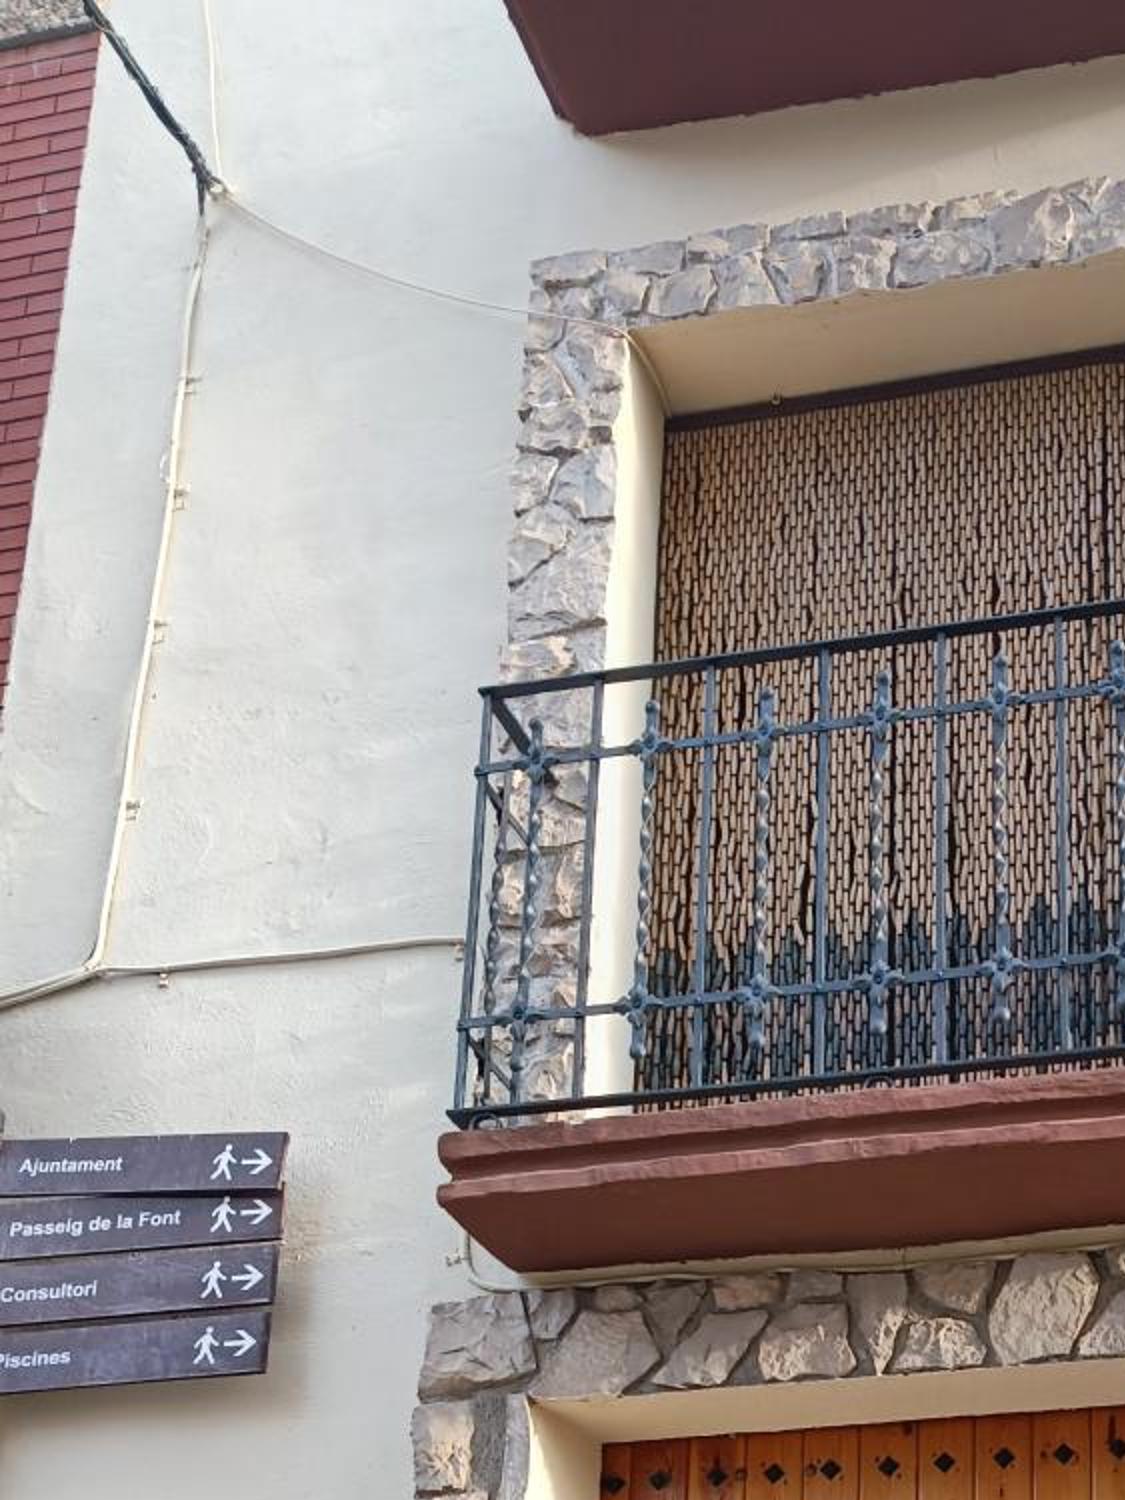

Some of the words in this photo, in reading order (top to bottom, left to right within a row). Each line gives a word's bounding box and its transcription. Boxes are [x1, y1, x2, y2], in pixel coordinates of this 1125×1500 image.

[19, 1157, 123, 1176] Ajuntament
[10, 1217, 83, 1236] Passeig
[89, 1216, 111, 1231] de
[117, 1214, 133, 1229] la
[139, 1210, 181, 1227] Font
[1, 1280, 97, 1302] Consultori
